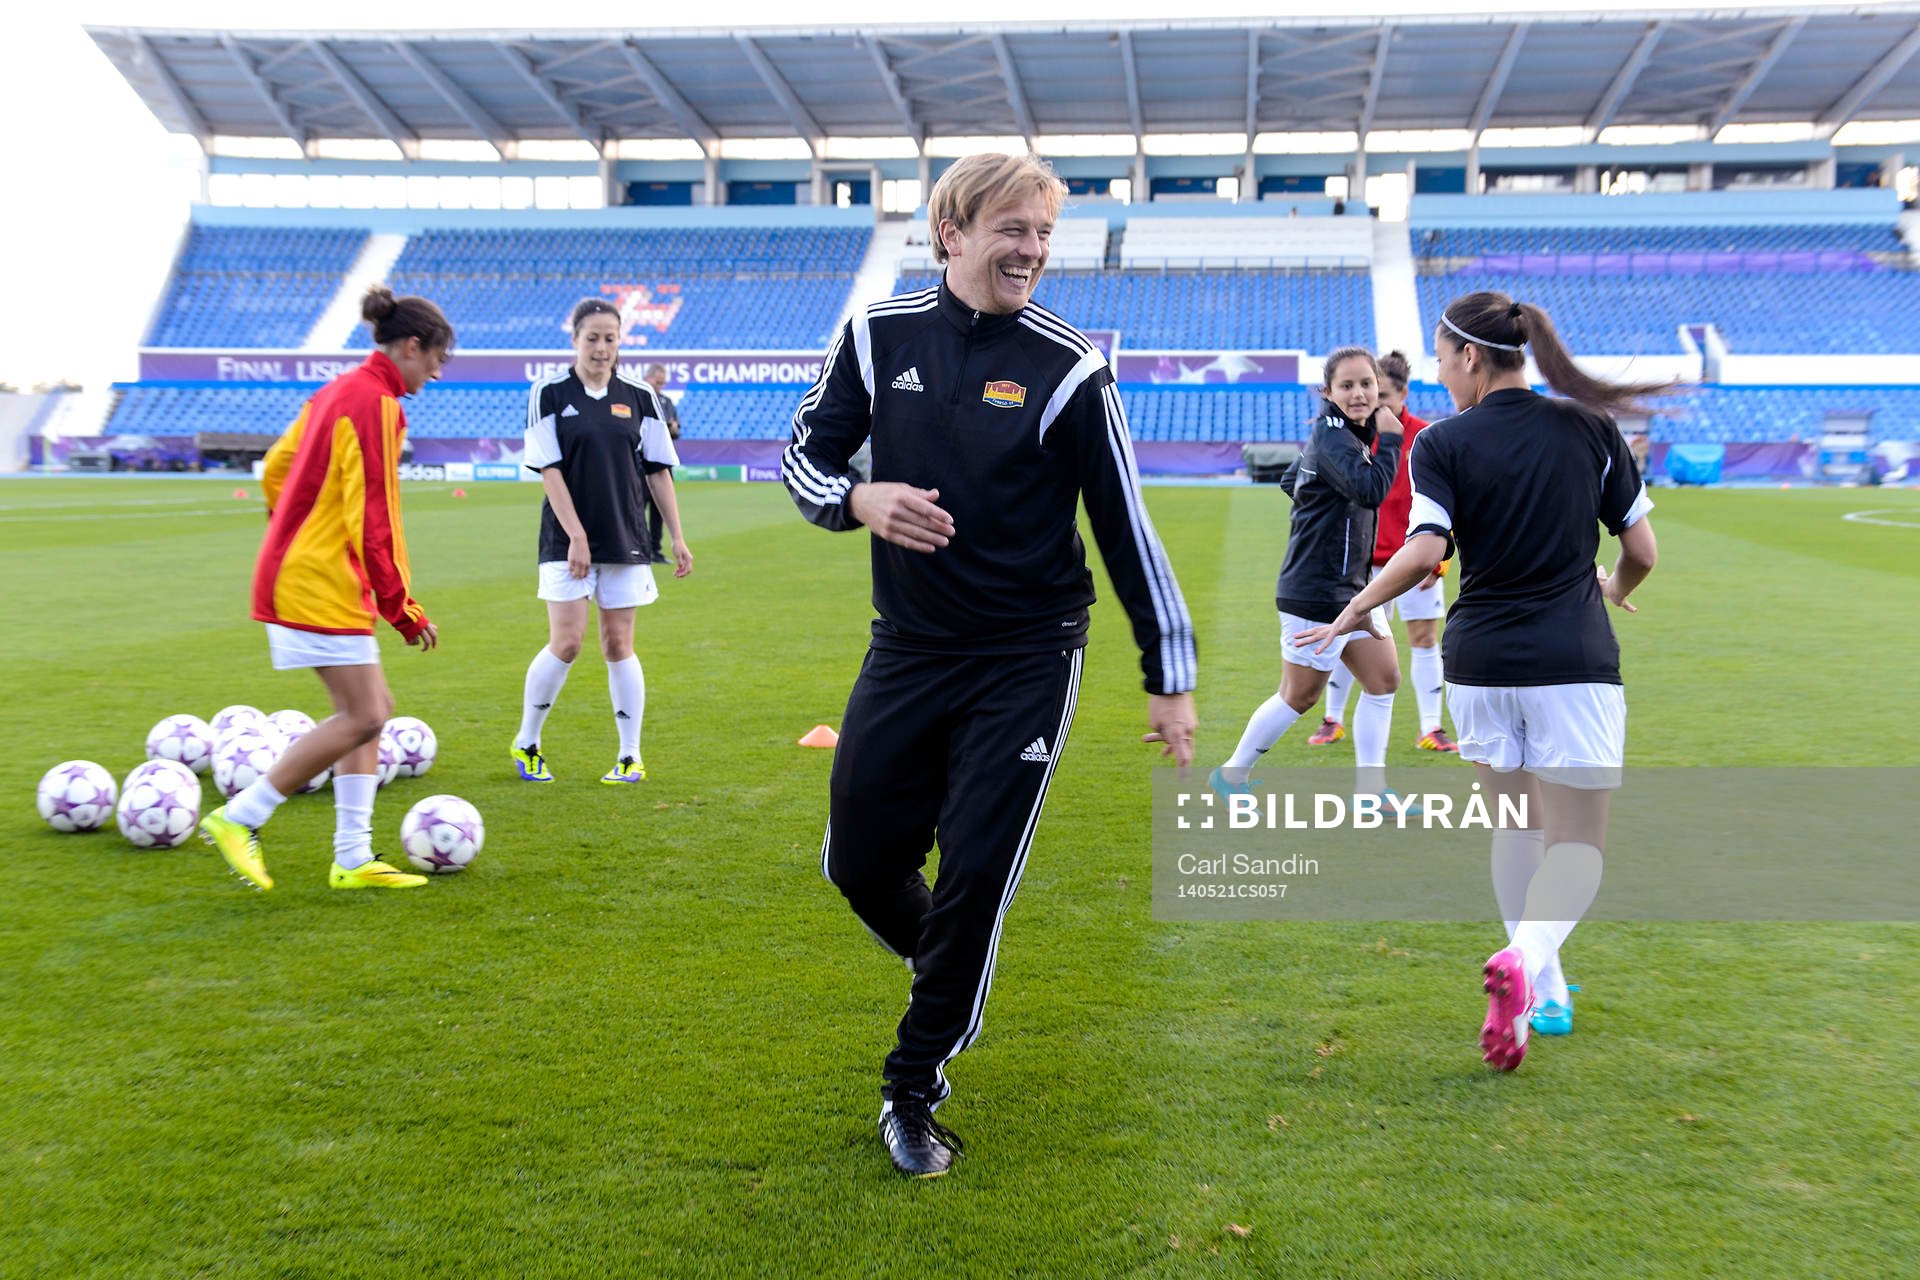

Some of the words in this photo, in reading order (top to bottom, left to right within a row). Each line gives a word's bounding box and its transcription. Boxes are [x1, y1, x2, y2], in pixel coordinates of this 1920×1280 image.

[217, 356, 290, 381] FINAL
[891, 380, 924, 392] adidas
[1020, 752, 1050, 762] adidas
